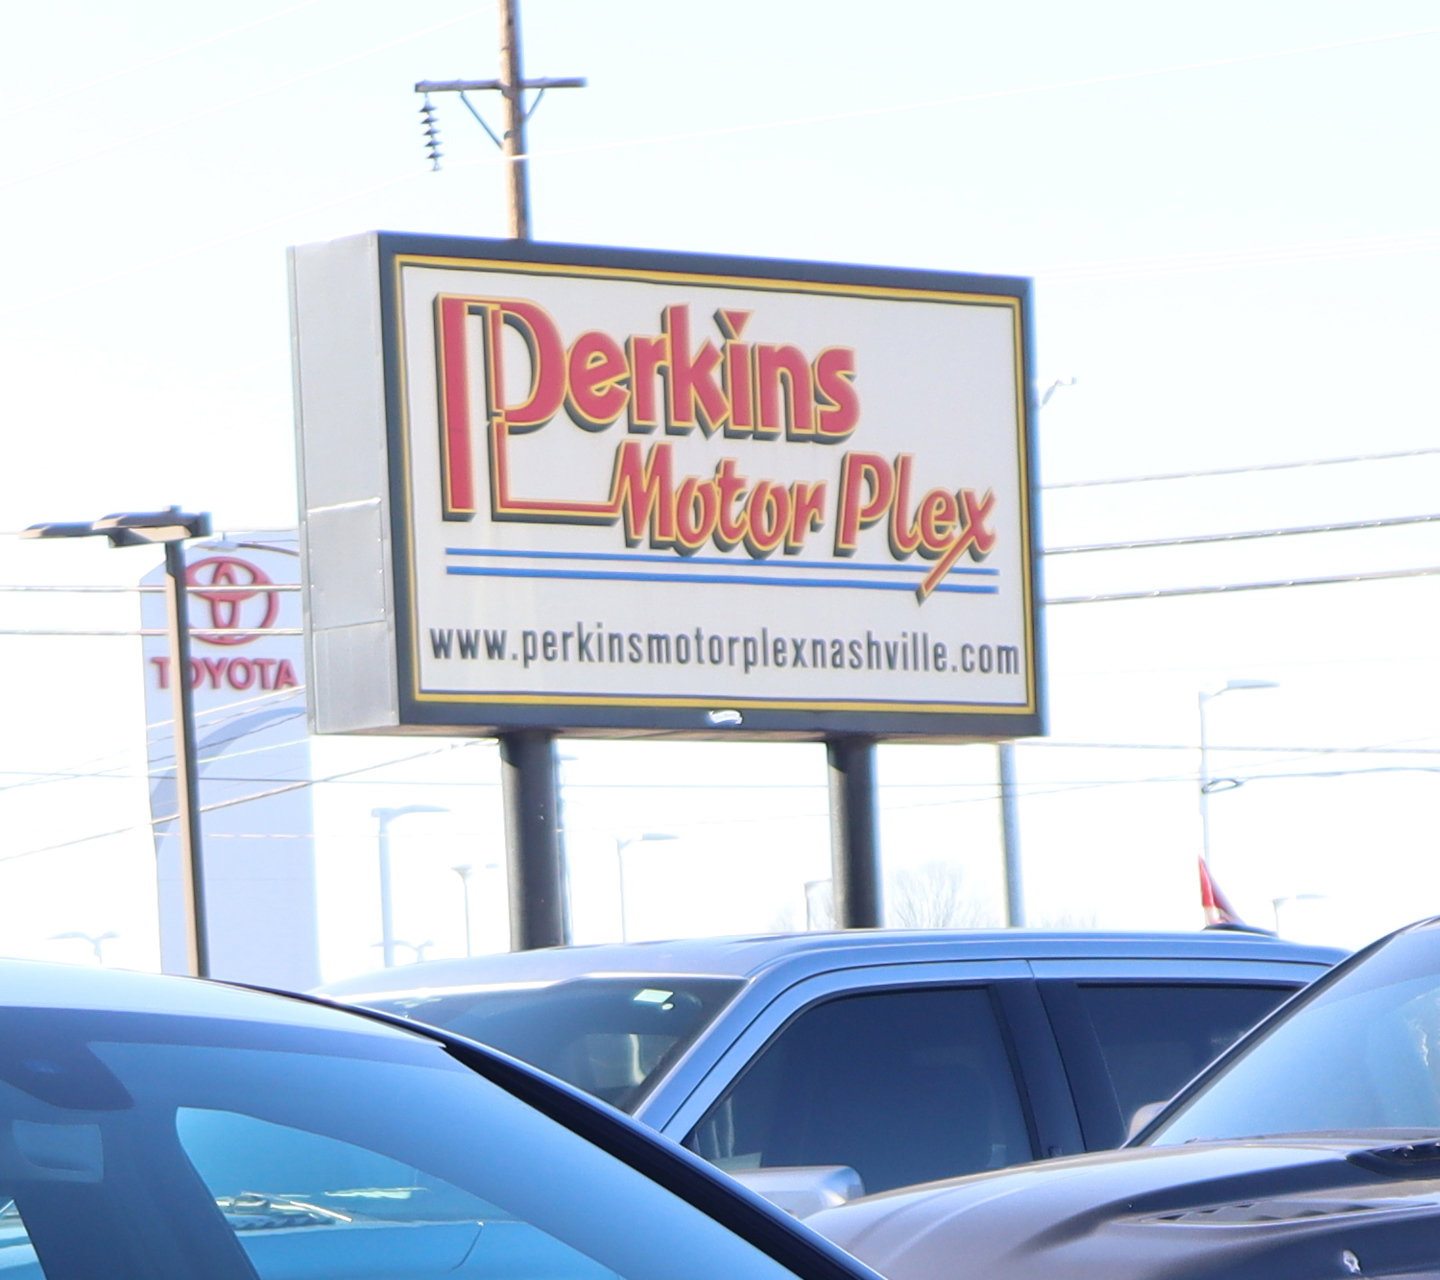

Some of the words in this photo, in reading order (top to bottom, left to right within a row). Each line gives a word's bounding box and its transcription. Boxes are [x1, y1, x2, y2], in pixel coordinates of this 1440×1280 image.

[434, 292, 863, 520] Perkins
[615, 441, 828, 556] Motor
[834, 450, 996, 604] Plex
[430, 623, 1020, 675] www.perkinsmotorplexnashville.com
